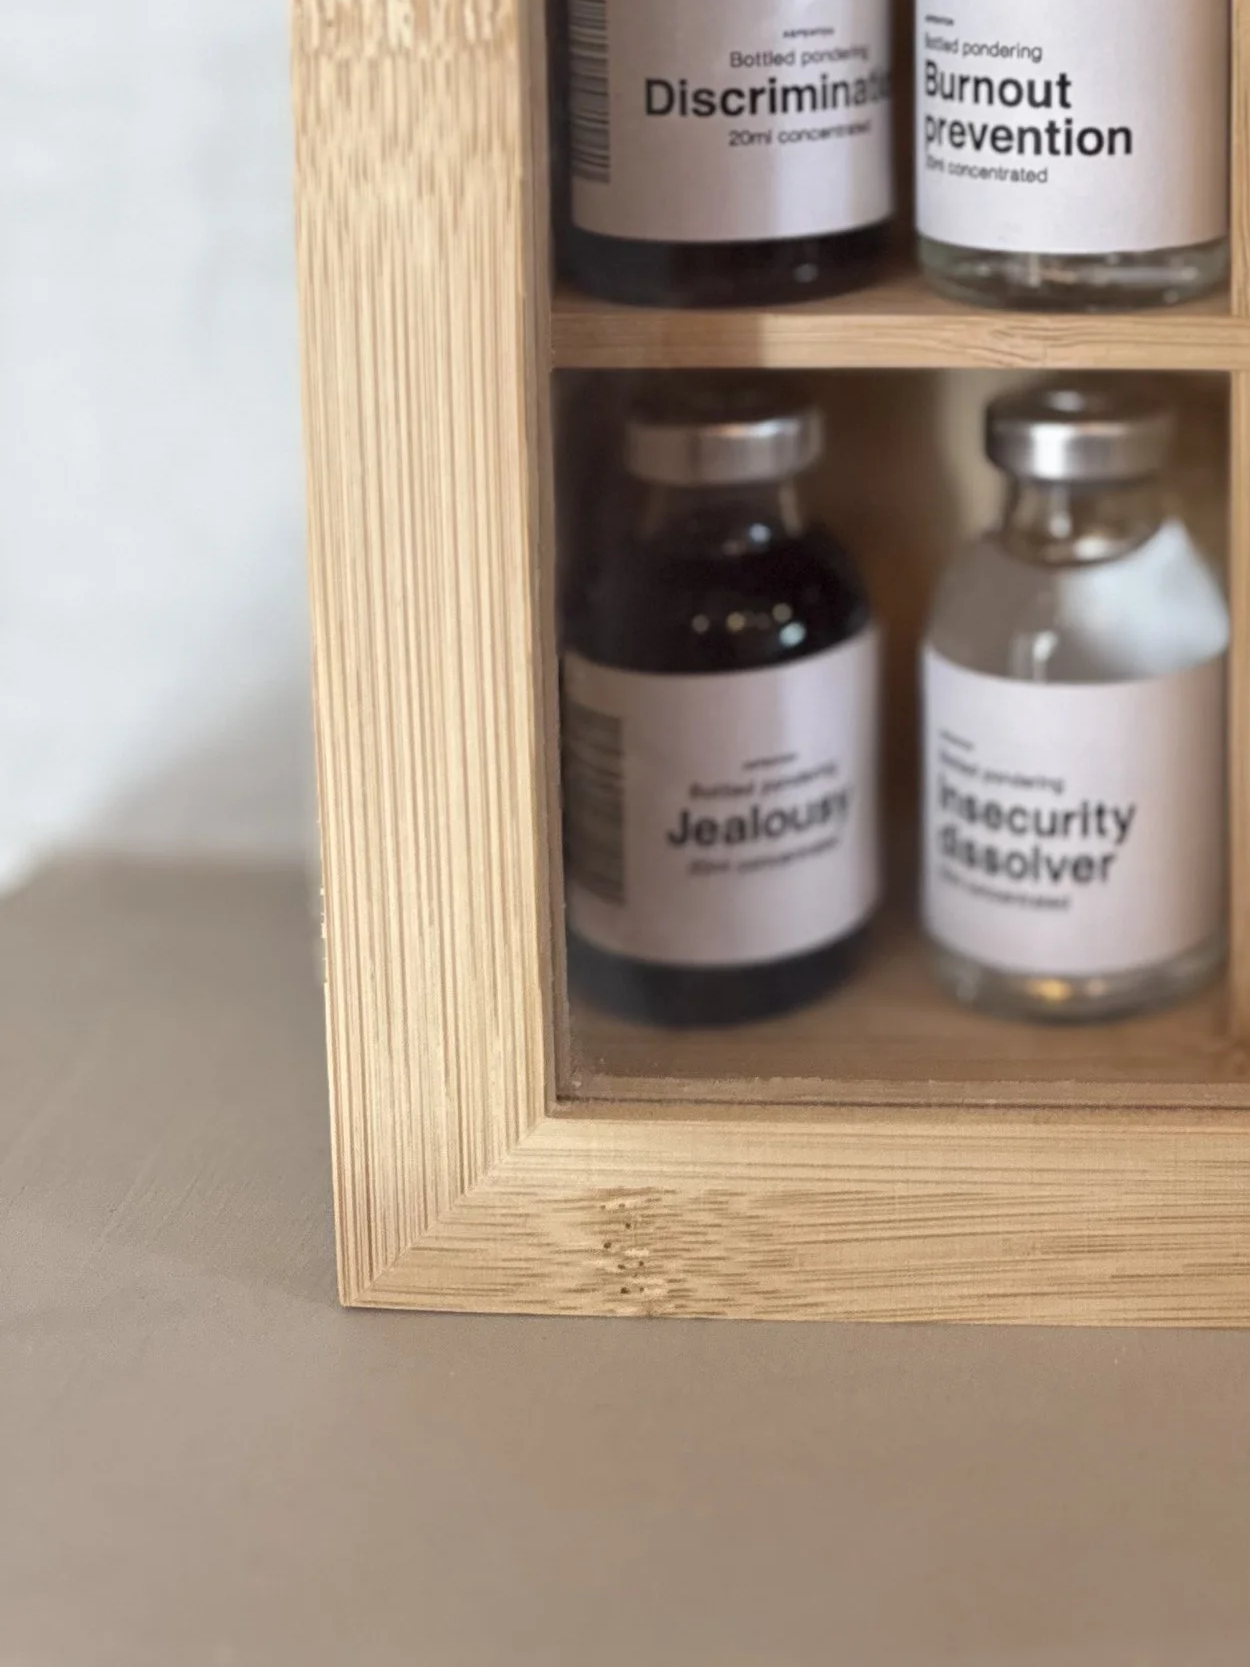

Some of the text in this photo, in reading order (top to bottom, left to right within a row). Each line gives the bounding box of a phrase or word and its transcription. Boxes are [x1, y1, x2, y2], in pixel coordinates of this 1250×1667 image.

[729, 49, 796, 69] Bottled
[962, 41, 1043, 64] pondering
[925, 59, 1072, 109] Burnout
[728, 129, 773, 147] 20ml
[925, 114, 1133, 157] prevention
[948, 161, 1048, 183] concentrated
